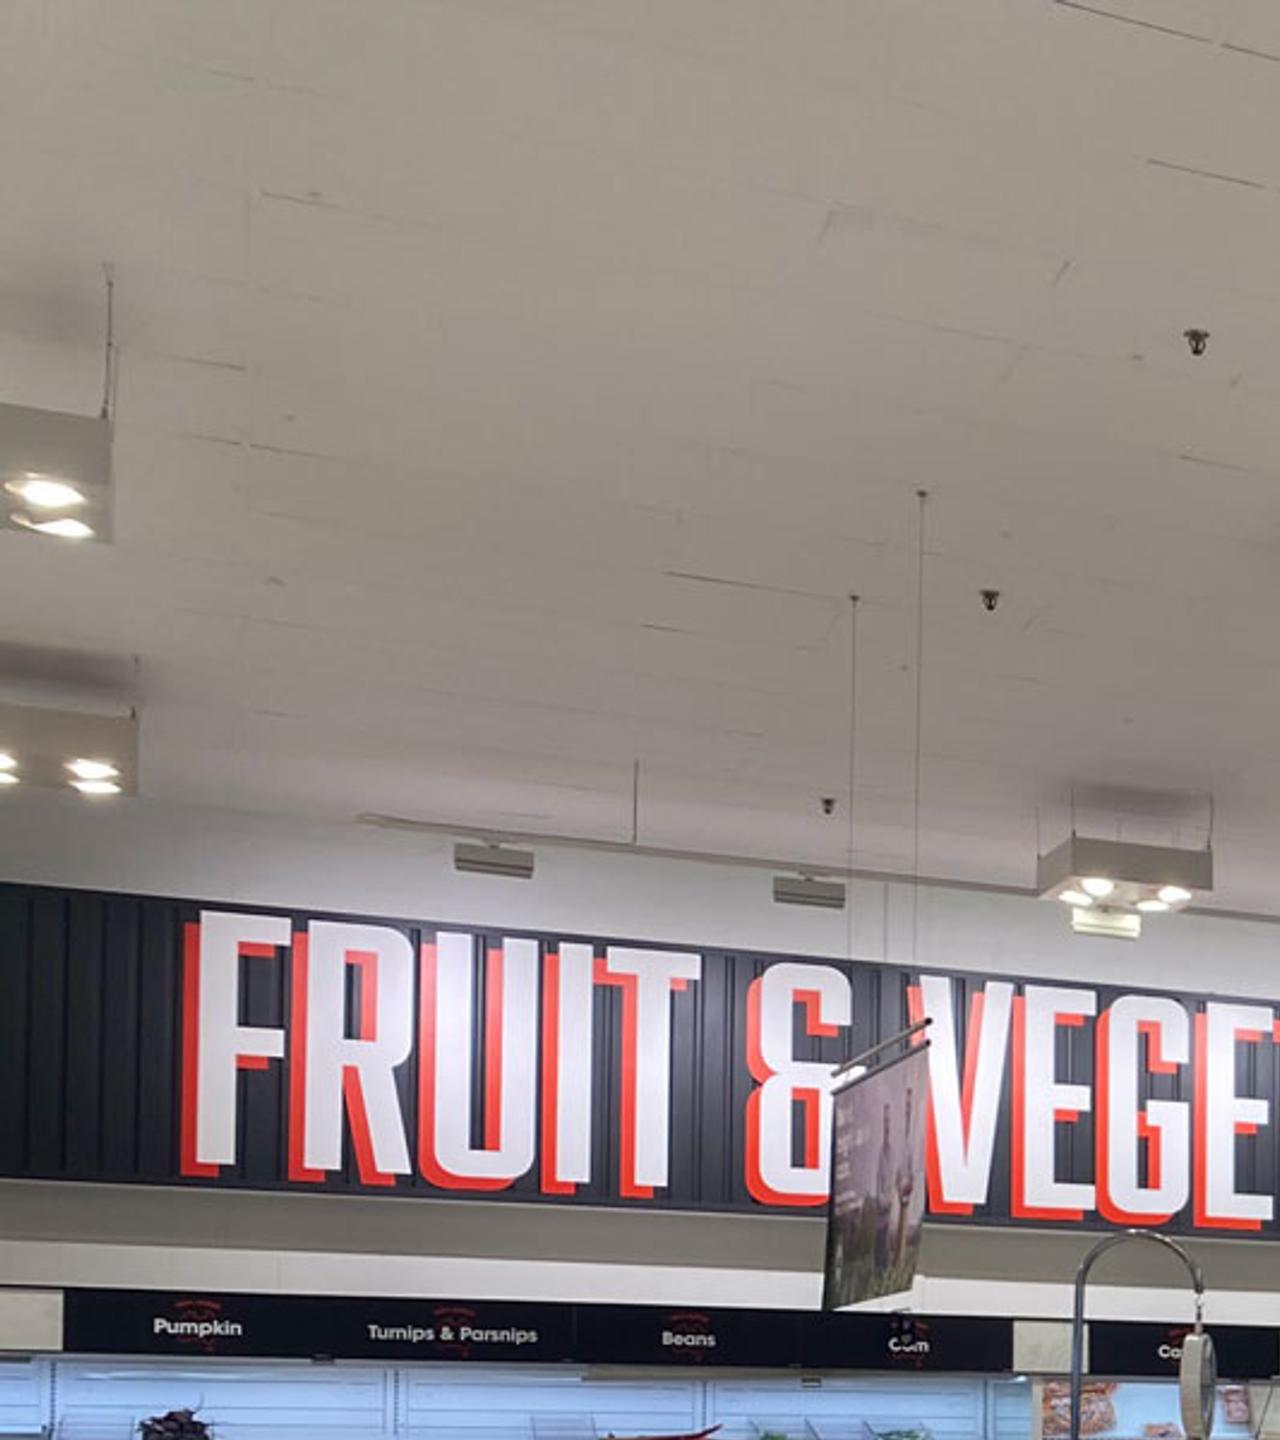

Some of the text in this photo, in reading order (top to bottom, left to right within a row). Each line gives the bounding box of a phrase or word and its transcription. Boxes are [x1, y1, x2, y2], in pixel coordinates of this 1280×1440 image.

[181, 908, 702, 1198] FRUIT
[745, 961, 854, 1206] &
[153, 1317, 243, 1339] Pumpkin
[368, 1325, 538, 1345] Turnips & Parsnips
[663, 1331, 715, 1347] Beans
